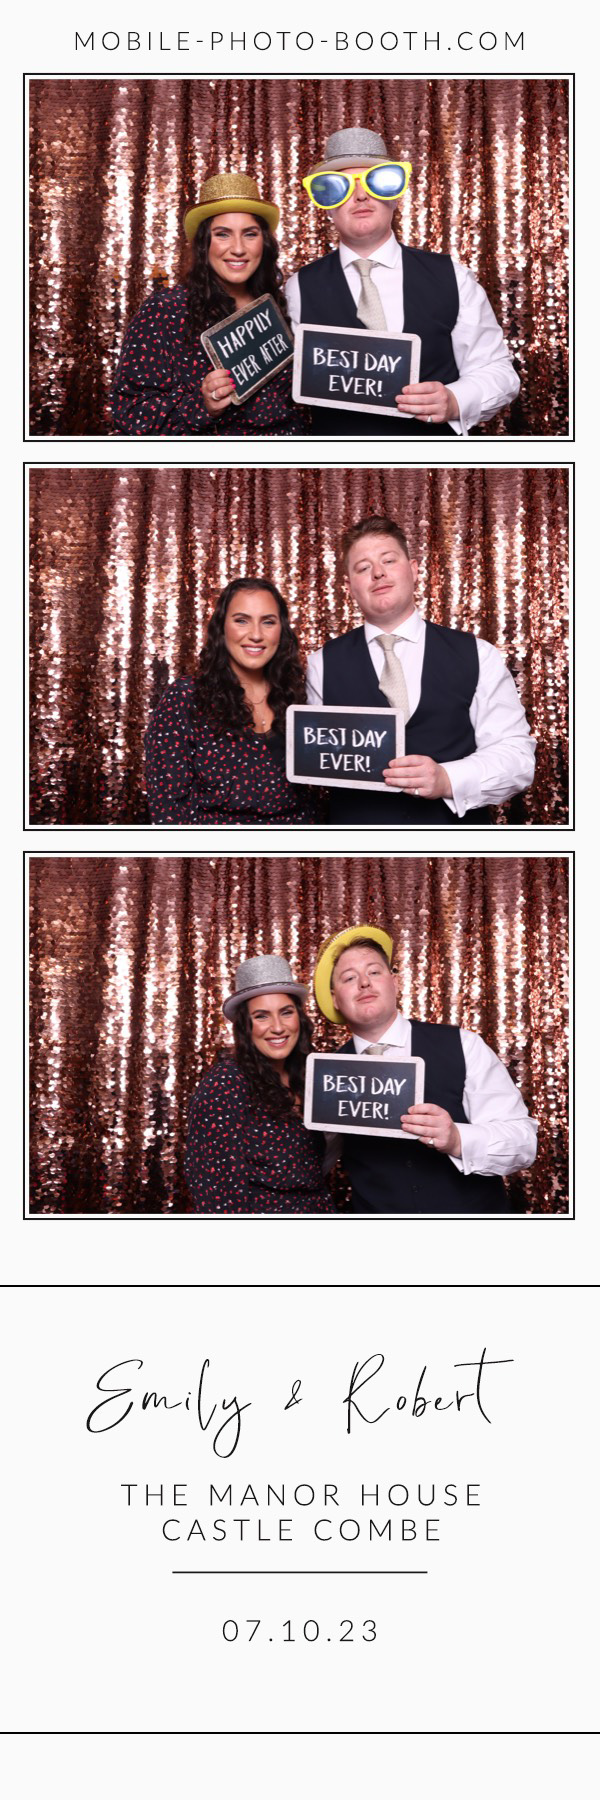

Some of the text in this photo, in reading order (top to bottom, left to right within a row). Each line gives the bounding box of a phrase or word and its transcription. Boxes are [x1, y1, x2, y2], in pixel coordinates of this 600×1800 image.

[217, 308, 272, 359] HAPPILY
[231, 333, 289, 386] EVER AFTER
[313, 348, 402, 374] BEST DAY
[328, 375, 383, 397] EVER!
[303, 727, 387, 748] BEST DAY
[319, 753, 371, 772] EVER!
[323, 1074, 407, 1096] BEST DAY
[338, 1100, 389, 1120] EVER!
